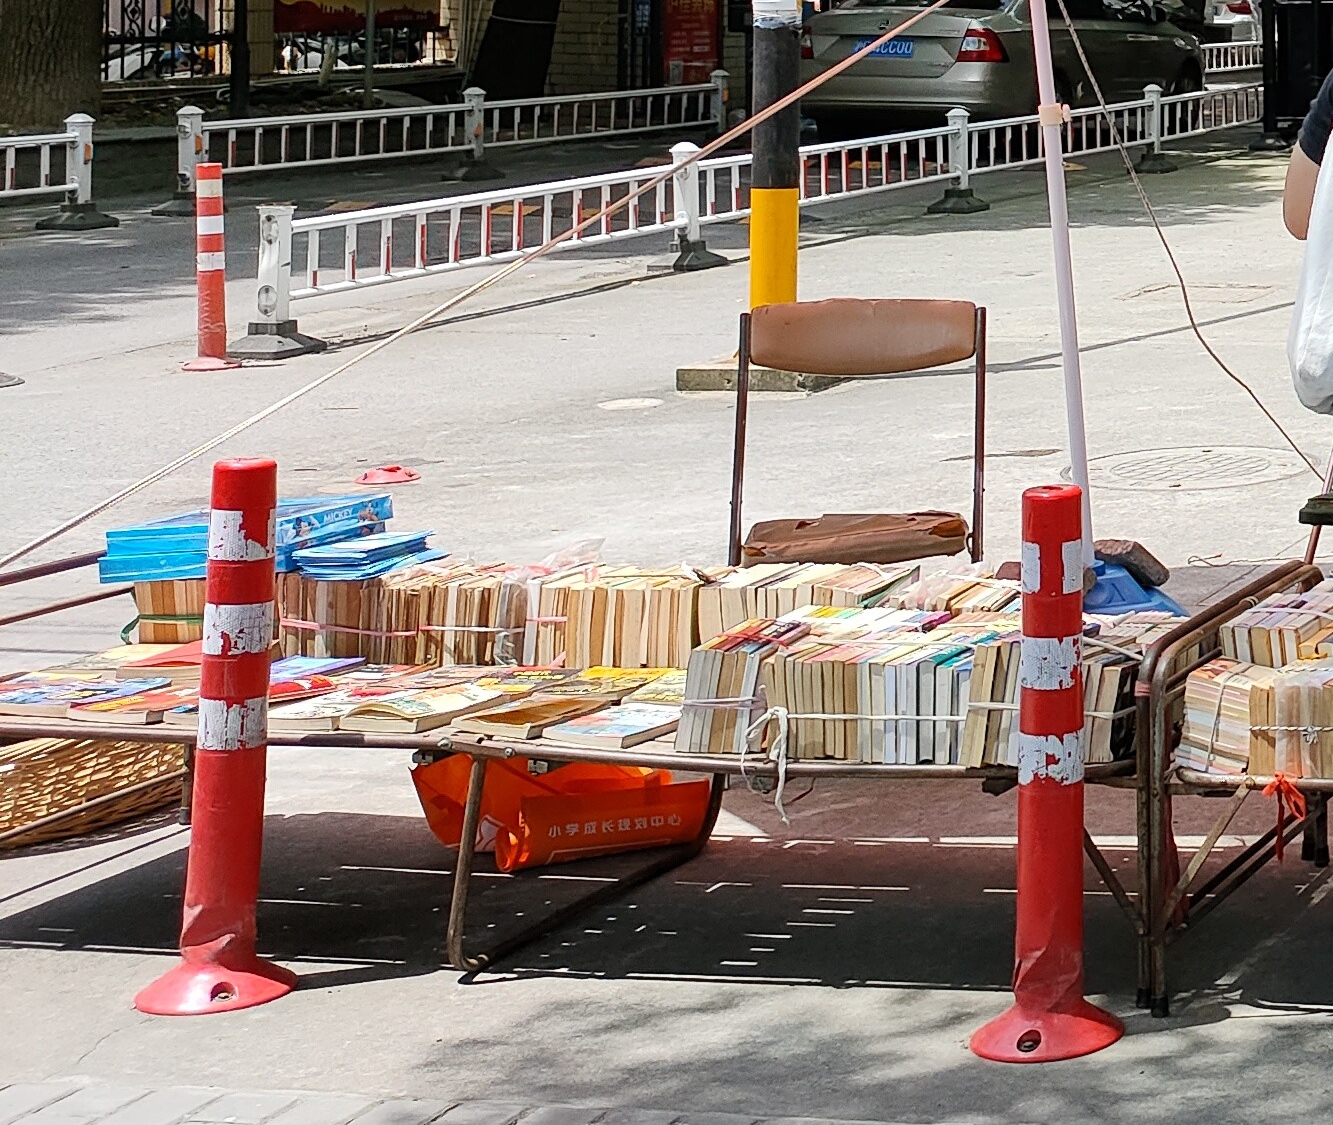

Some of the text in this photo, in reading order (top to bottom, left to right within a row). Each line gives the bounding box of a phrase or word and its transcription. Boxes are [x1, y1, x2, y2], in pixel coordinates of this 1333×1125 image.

[323, 507, 354, 522] MICKEY
[548, 813, 682, 839] 小学成长规划中心
